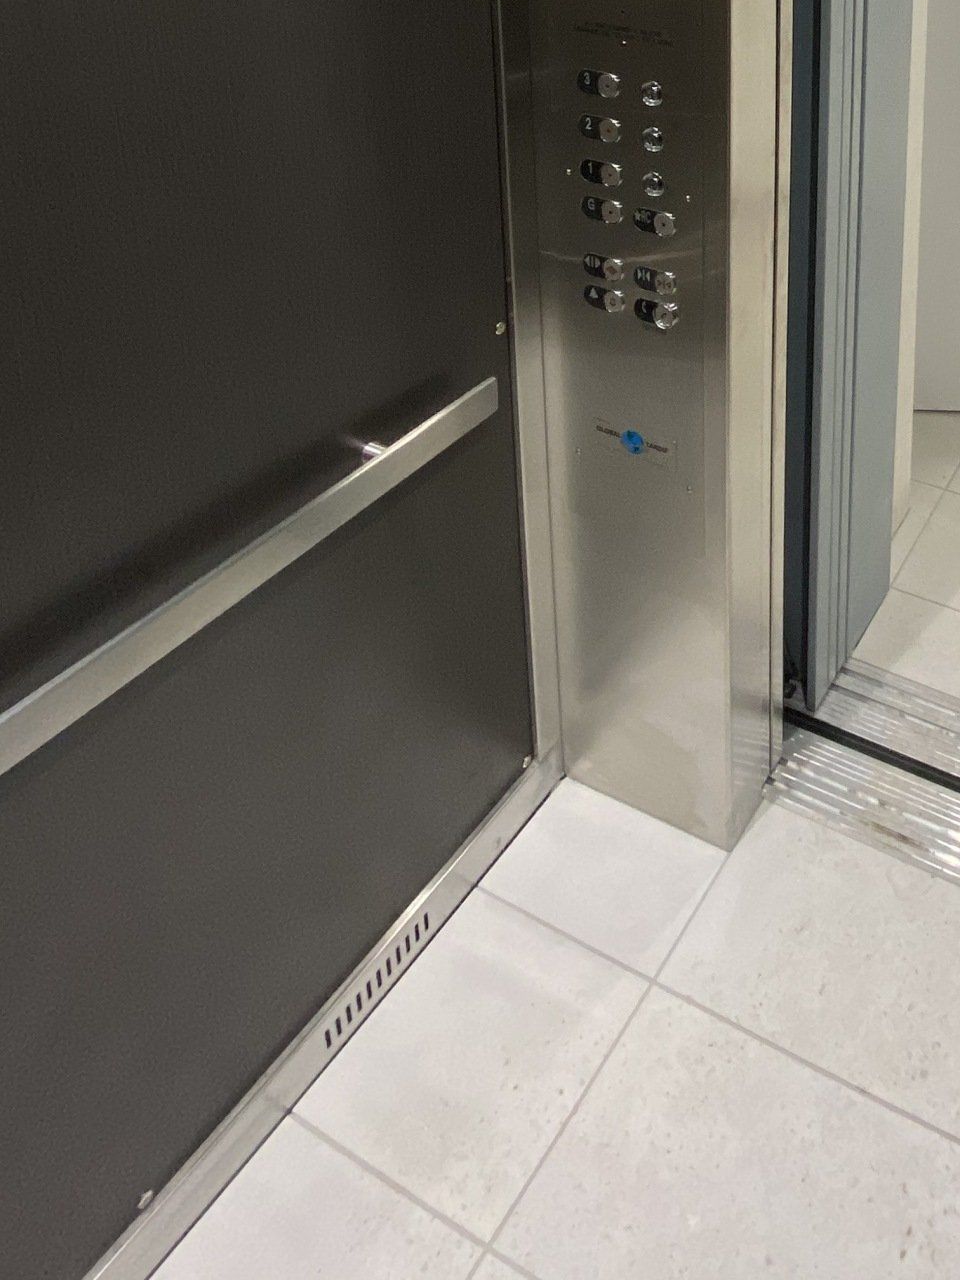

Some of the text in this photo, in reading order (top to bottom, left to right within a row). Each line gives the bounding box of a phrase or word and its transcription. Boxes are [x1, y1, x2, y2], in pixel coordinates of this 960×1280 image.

[583, 72, 591, 85] 3
[585, 117, 592, 130] 2
[587, 162, 593, 174] 1
[587, 198, 595, 211] G
